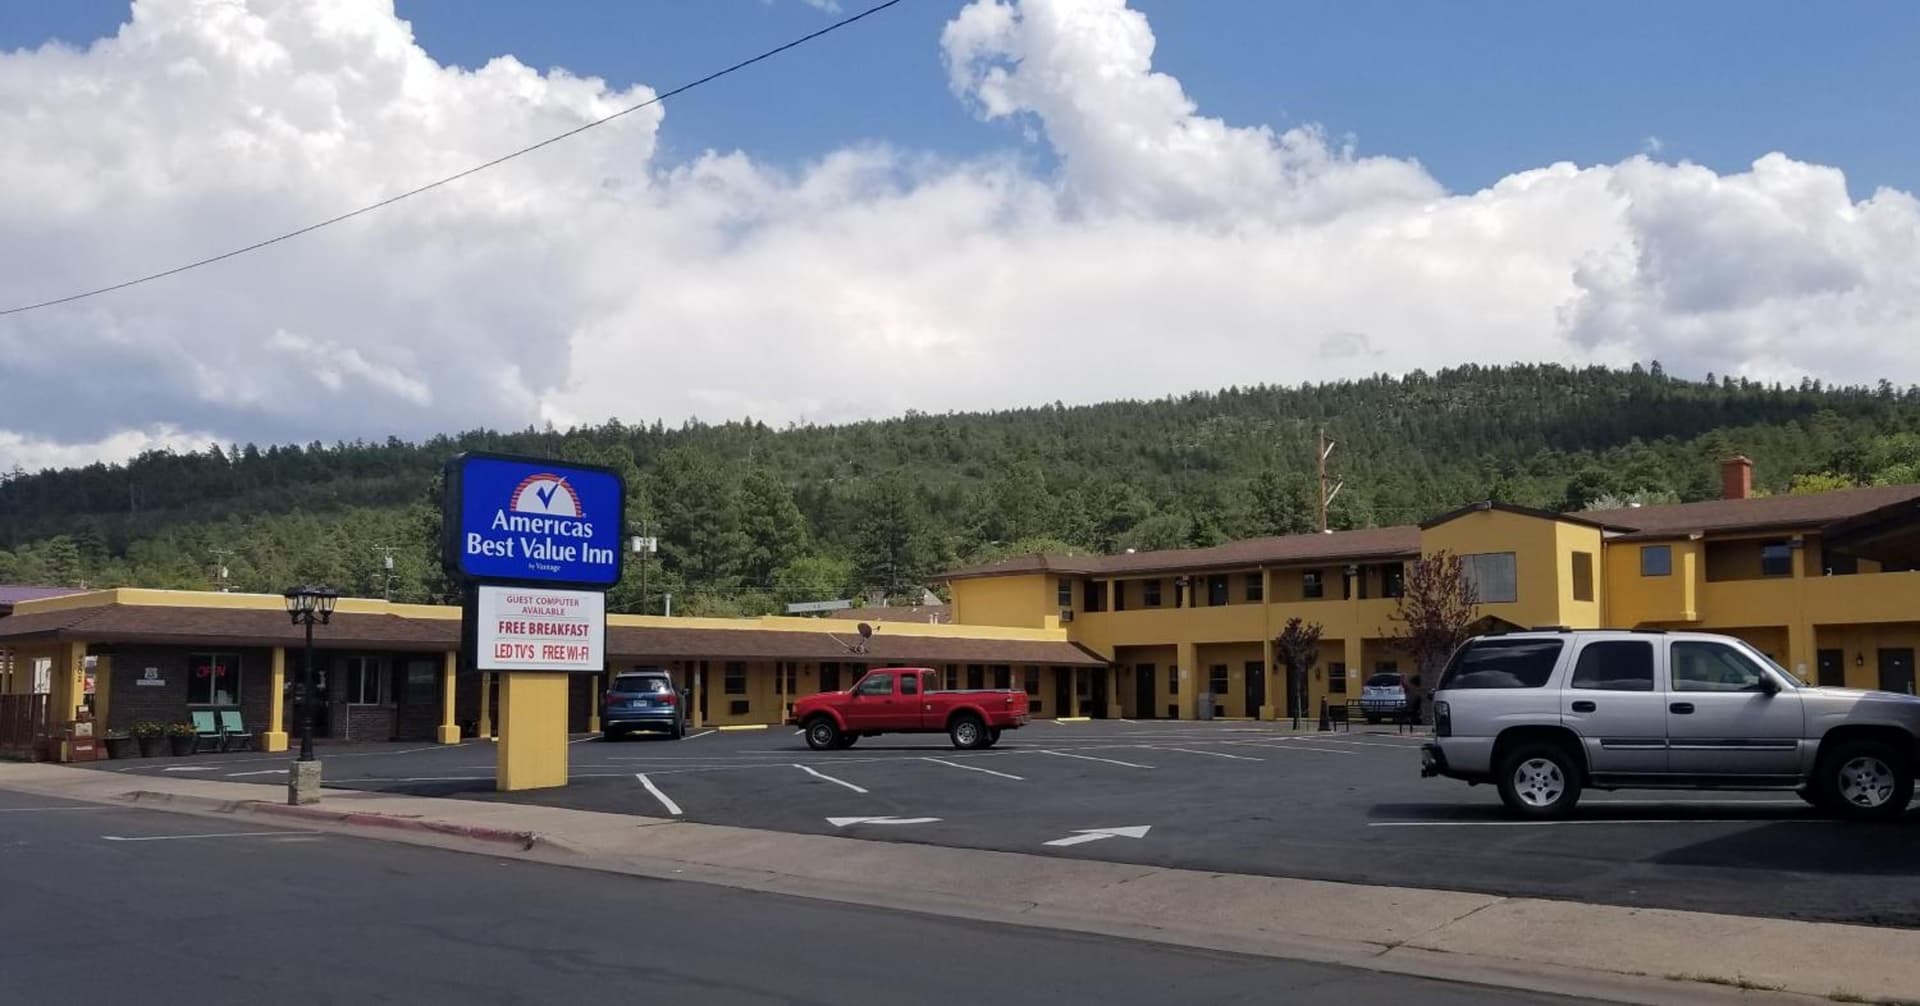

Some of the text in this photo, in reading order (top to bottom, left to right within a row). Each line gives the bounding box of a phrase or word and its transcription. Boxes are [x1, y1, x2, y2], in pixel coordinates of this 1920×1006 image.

[491, 509, 593, 538] Americas
[467, 532, 614, 565] Best Value Inn
[506, 595, 579, 607] GUEST COMPUTER
[521, 607, 565, 616] AVAILABLE
[499, 621, 589, 637] FREE BREAKFAST
[494, 643, 589, 661] LED TV'S FREE WI-FI
